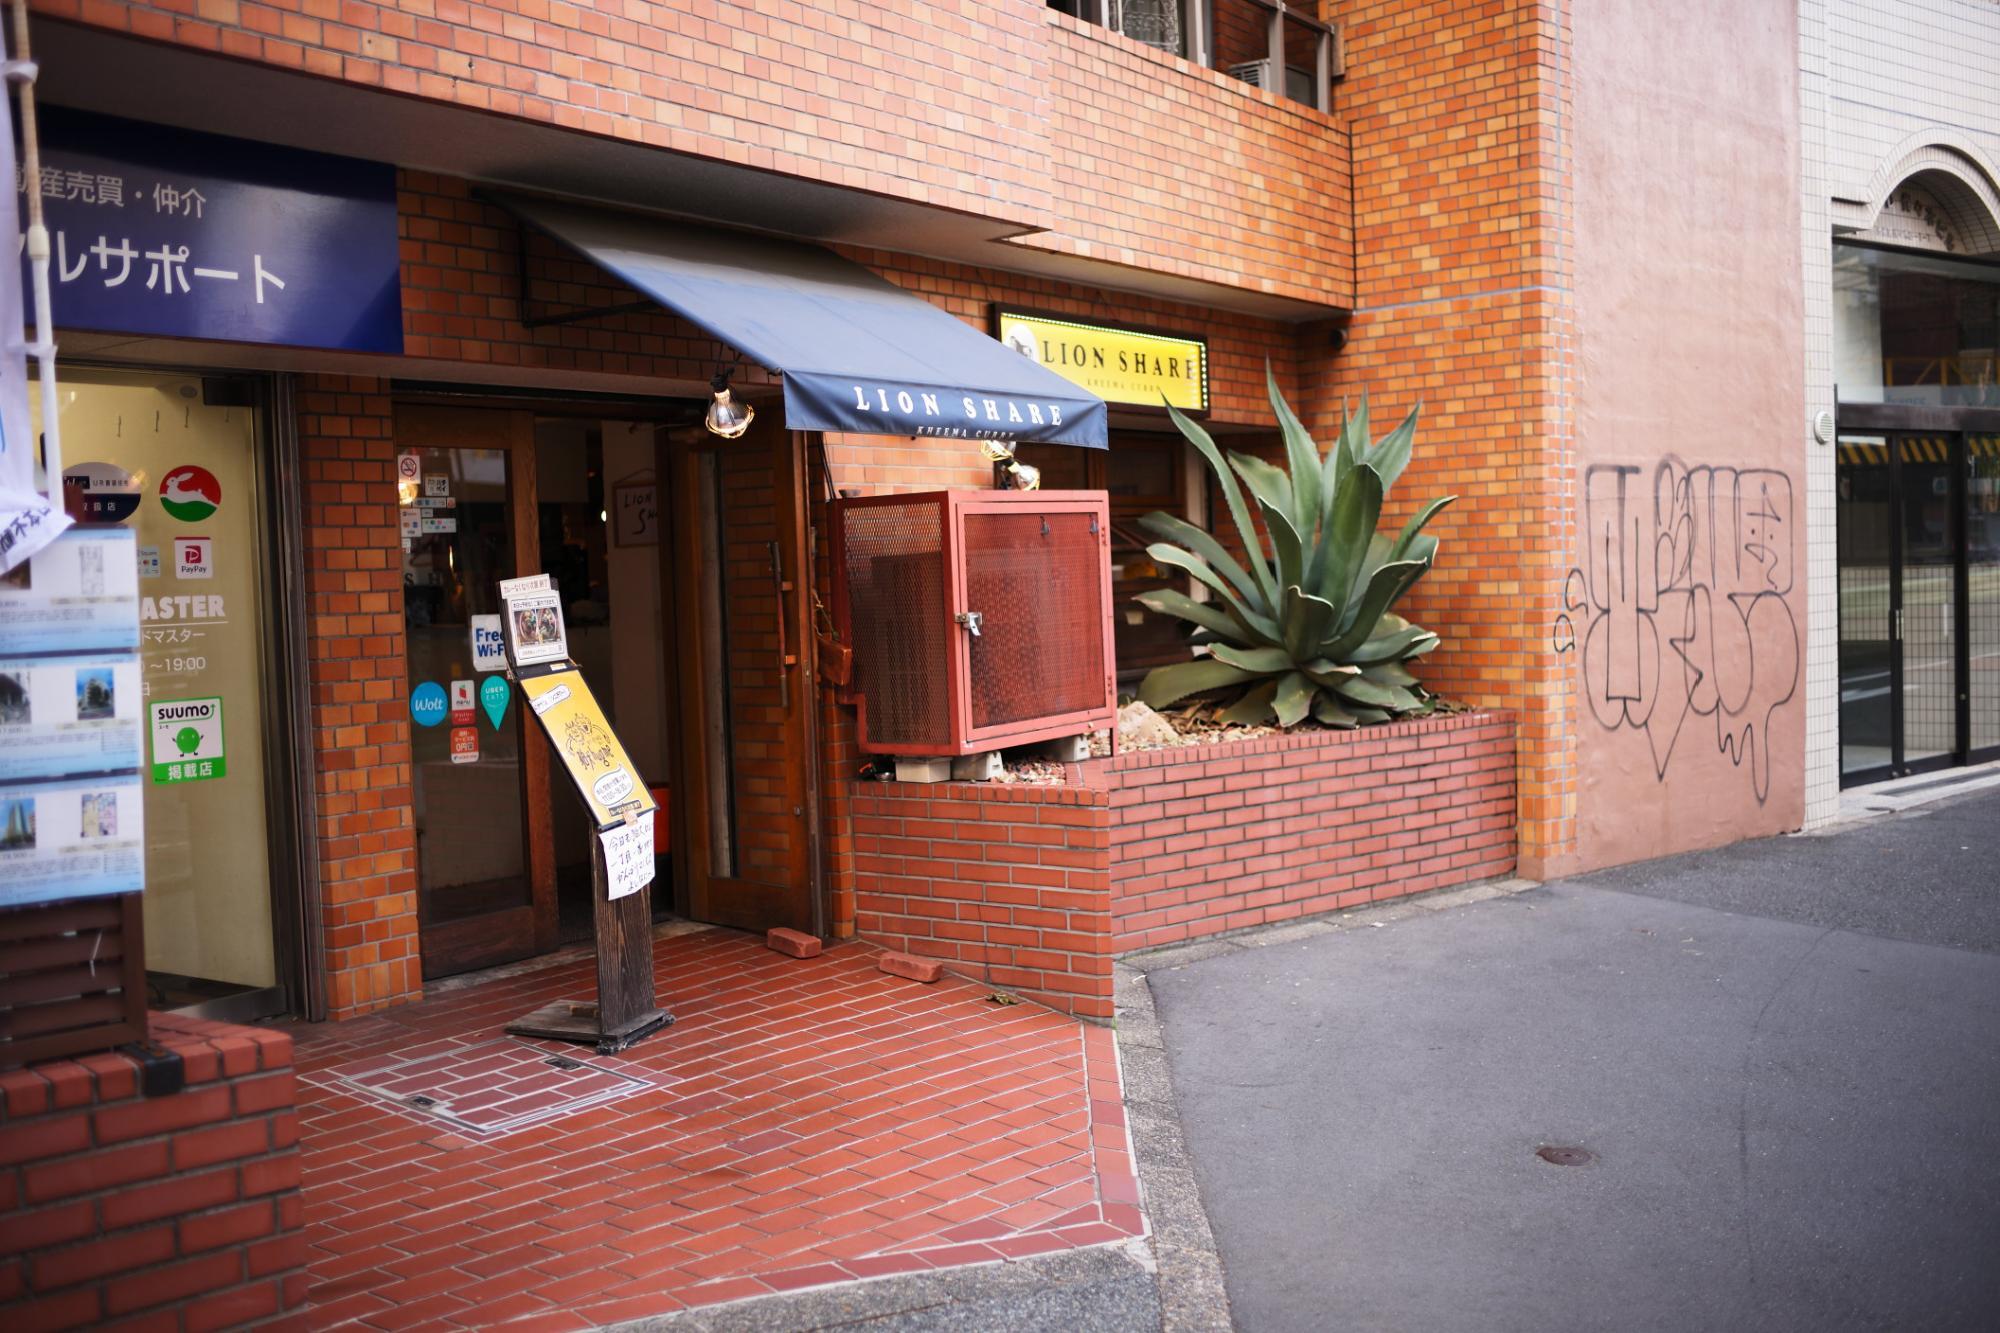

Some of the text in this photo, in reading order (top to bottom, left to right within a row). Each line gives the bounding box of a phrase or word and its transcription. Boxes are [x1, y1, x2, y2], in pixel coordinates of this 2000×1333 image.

[20, 231, 285, 304] ルサポート
[1043, 340, 1194, 380] LION SHARE
[854, 386, 1063, 426] LION SHARE
[916, 426, 1016, 440] KHEEMA CURRY
[181, 565, 207, 574] PayPay
[141, 595, 226, 620] ASTER
[415, 698, 444, 712] Wolt
[168, 762, 213, 781] 掲載店
